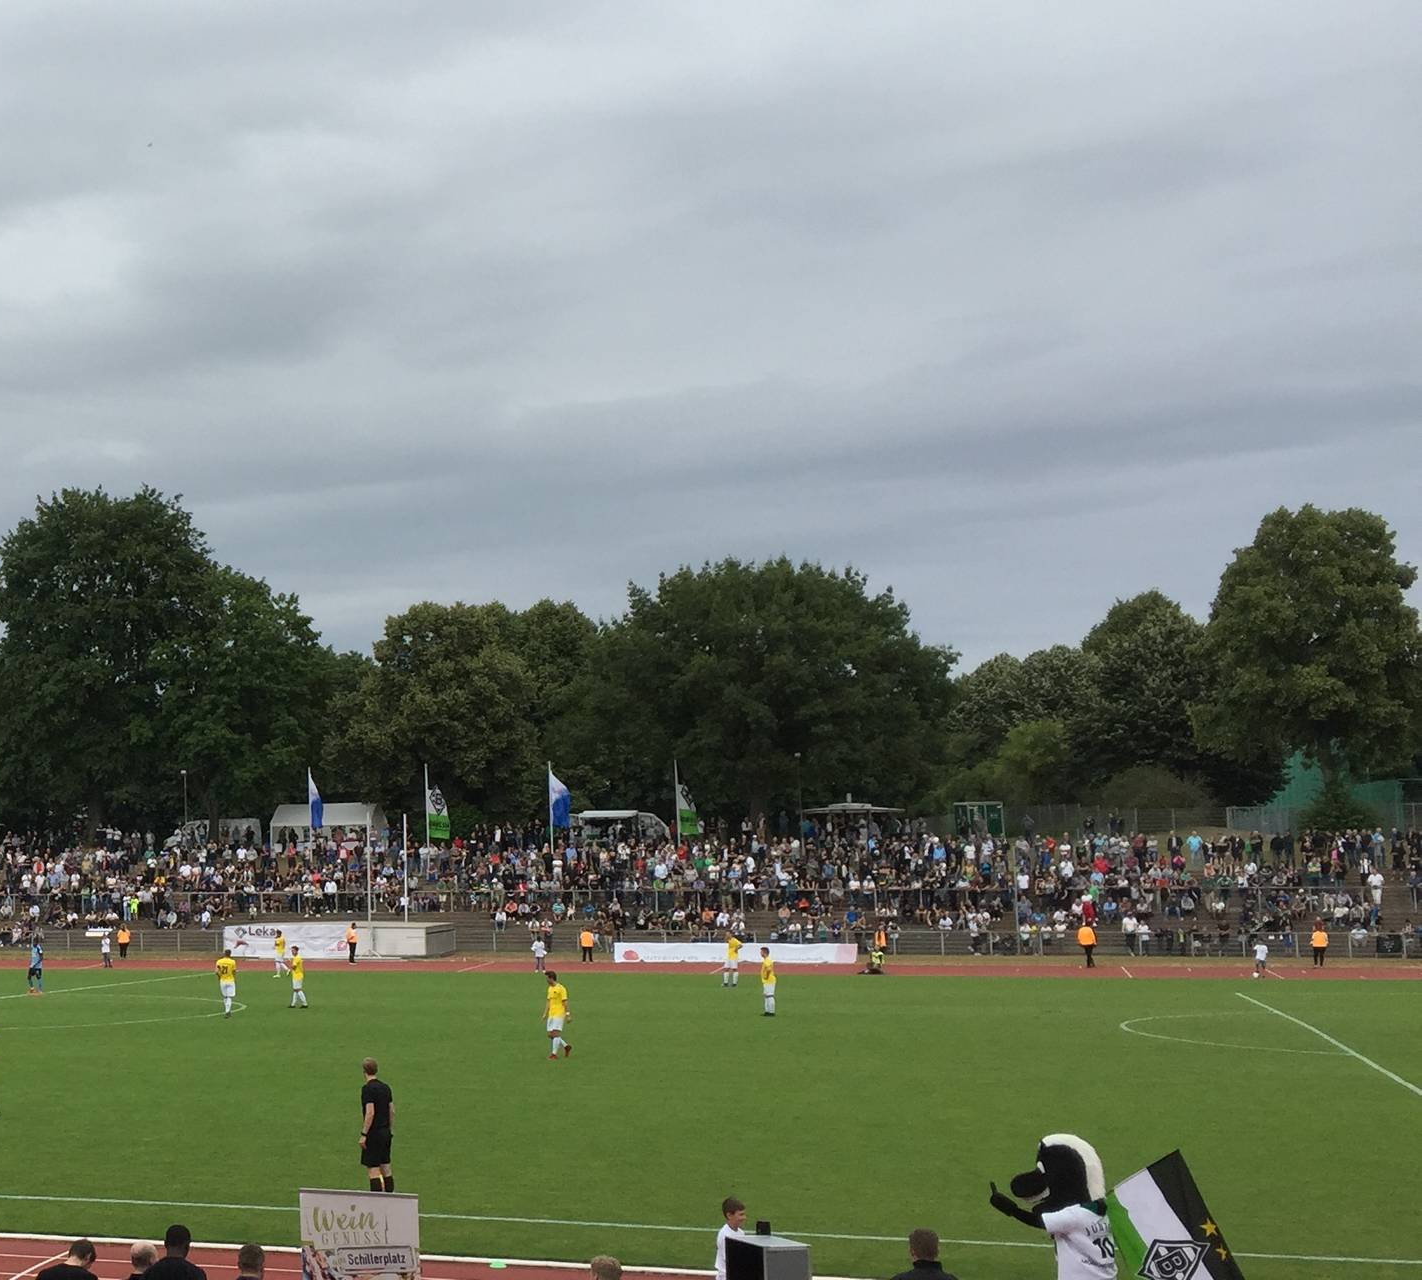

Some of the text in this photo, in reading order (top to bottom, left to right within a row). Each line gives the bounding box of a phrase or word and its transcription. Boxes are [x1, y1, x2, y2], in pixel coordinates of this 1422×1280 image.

[313, 1204, 379, 1233] Wein
[347, 1252, 407, 1266] Schillerplatz
[1092, 1237, 1116, 1259] 10
